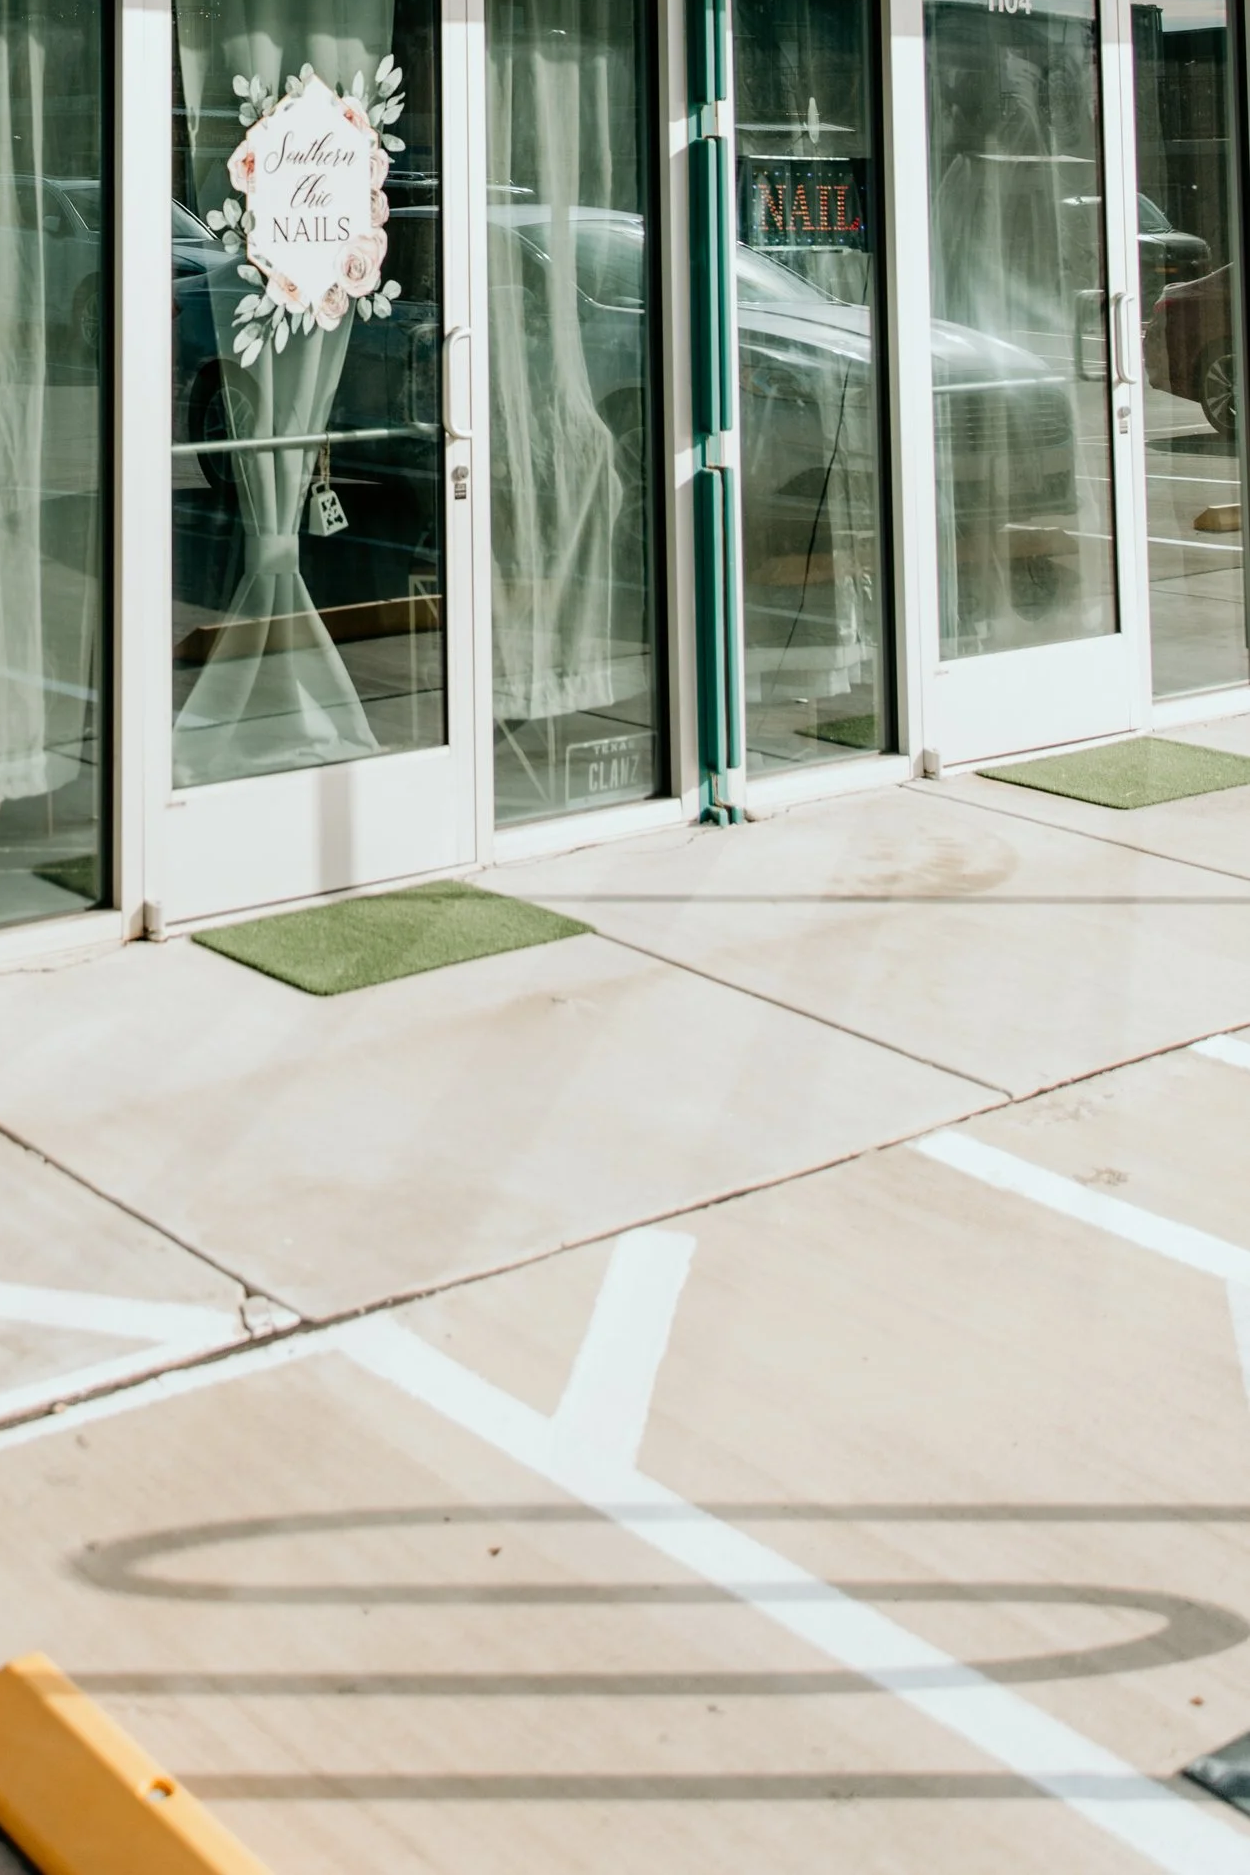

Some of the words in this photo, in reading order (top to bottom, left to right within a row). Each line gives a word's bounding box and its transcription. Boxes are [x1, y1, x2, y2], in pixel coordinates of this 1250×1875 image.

[264, 130, 357, 174] Southern
[290, 173, 334, 209] Chic
[757, 183, 860, 231] NAIL
[272, 217, 351, 243] NAILS
